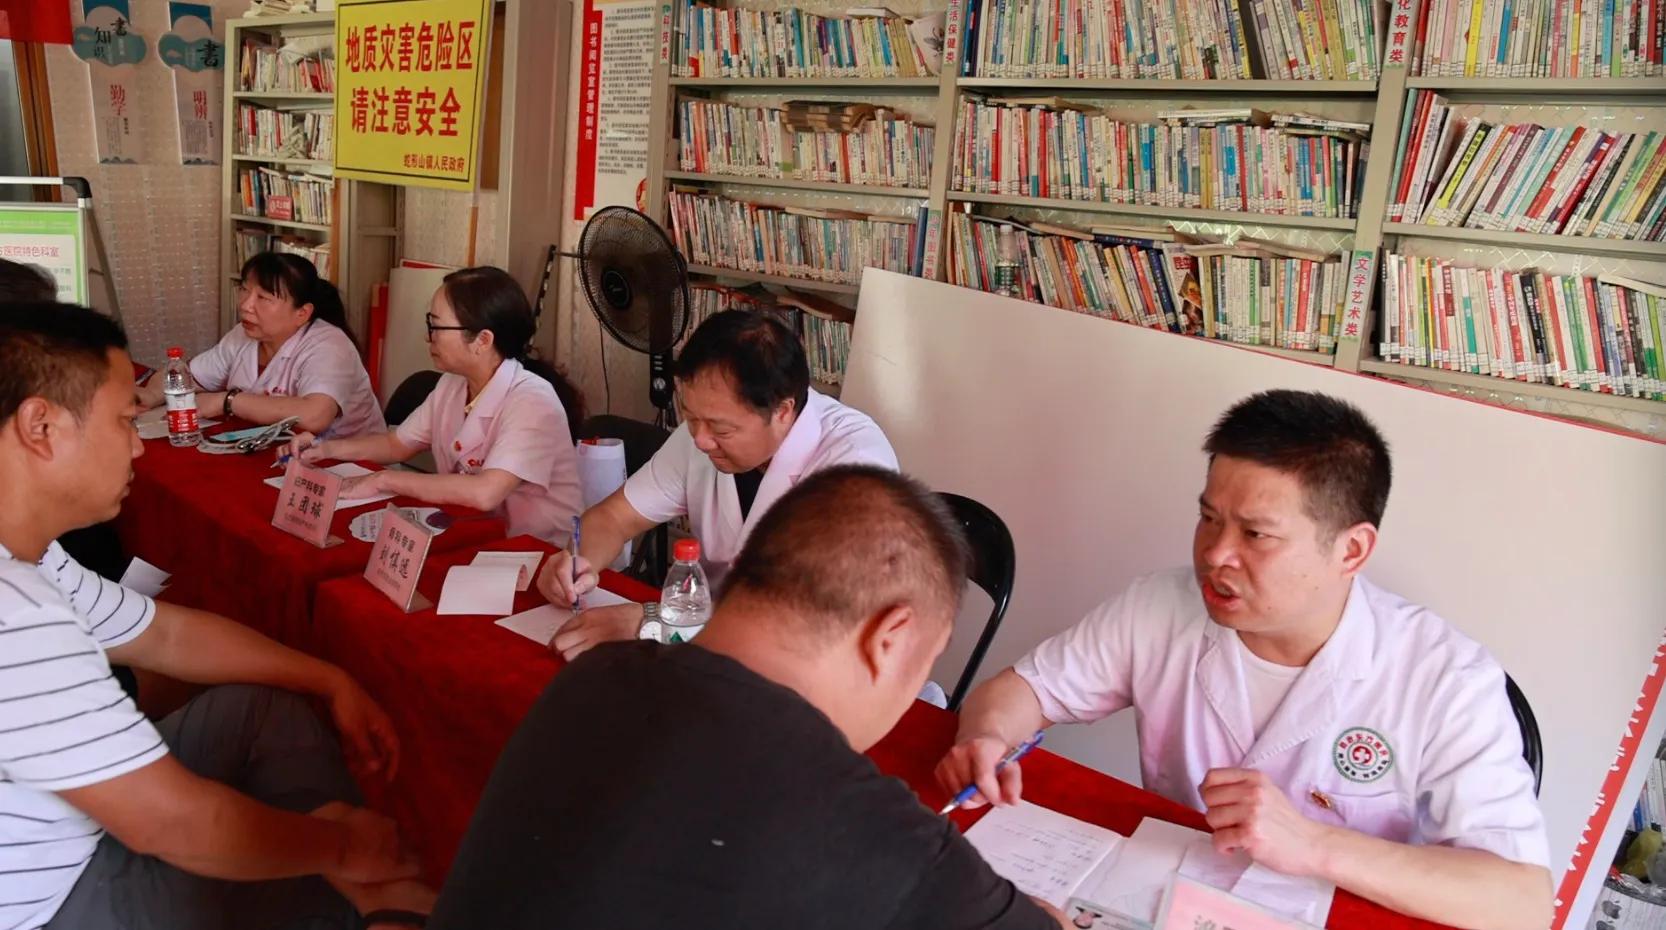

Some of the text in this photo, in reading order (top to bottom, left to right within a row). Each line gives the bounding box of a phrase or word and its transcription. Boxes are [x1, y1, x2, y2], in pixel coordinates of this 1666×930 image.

[346, 21, 475, 73] 地质灾害危险区
[351, 86, 461, 136] 请注意安全
[404, 153, 465, 173] 蛇形山镇人民政府
[0, 246, 60, 257] 医院特色科室
[1344, 257, 1368, 337] 文学艺术类
